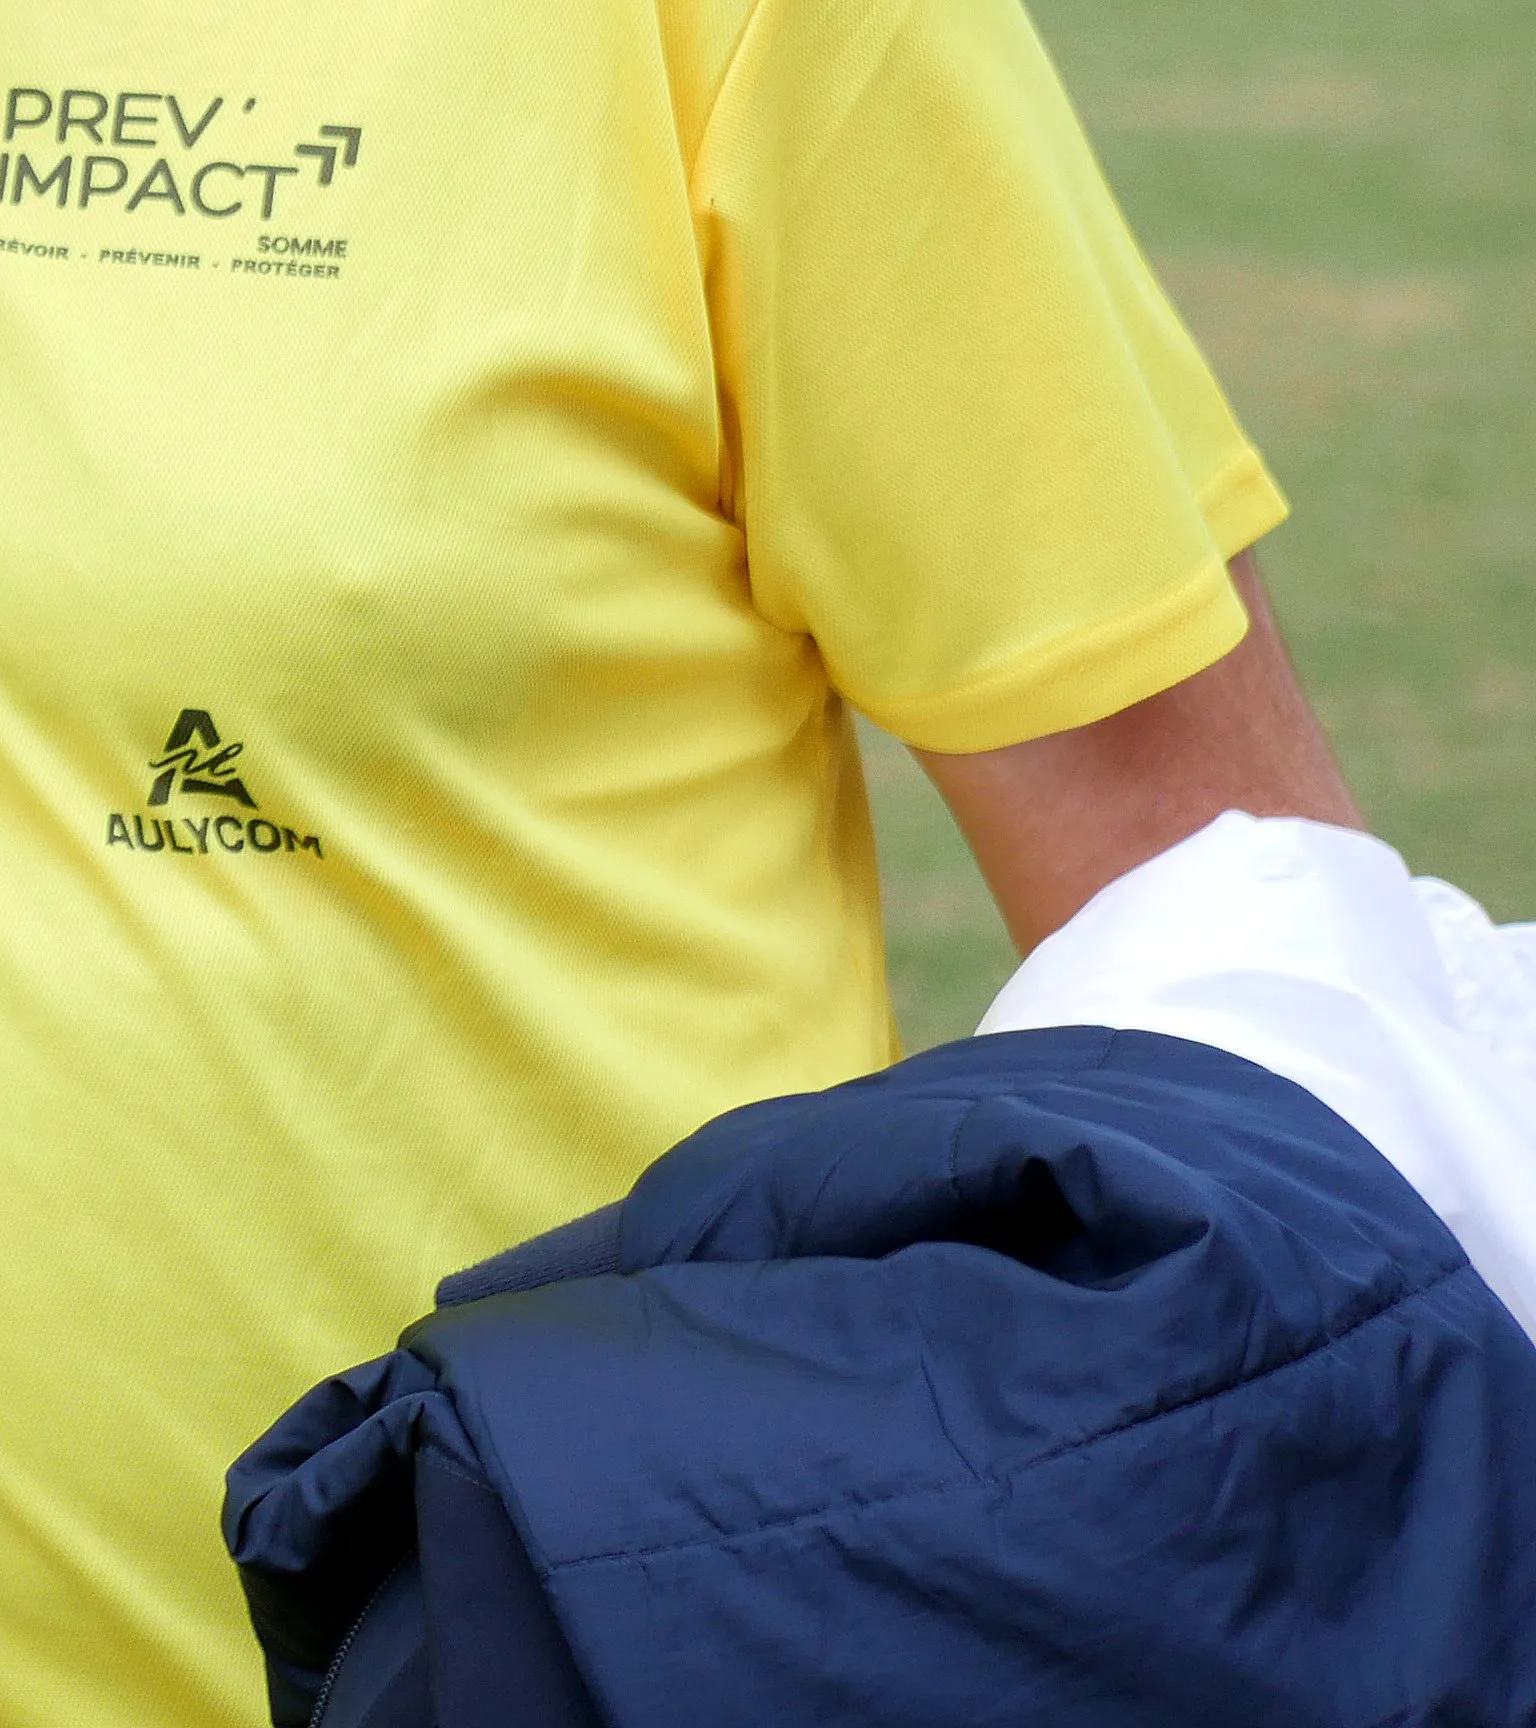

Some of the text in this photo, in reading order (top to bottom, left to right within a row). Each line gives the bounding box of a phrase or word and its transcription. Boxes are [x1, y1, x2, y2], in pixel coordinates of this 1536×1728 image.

[98, 246, 201, 270] PRÉVENIR
[231, 258, 342, 282] PROTÉGER
[257, 234, 348, 260] SOMME
[106, 812, 324, 860] AULYCOM
